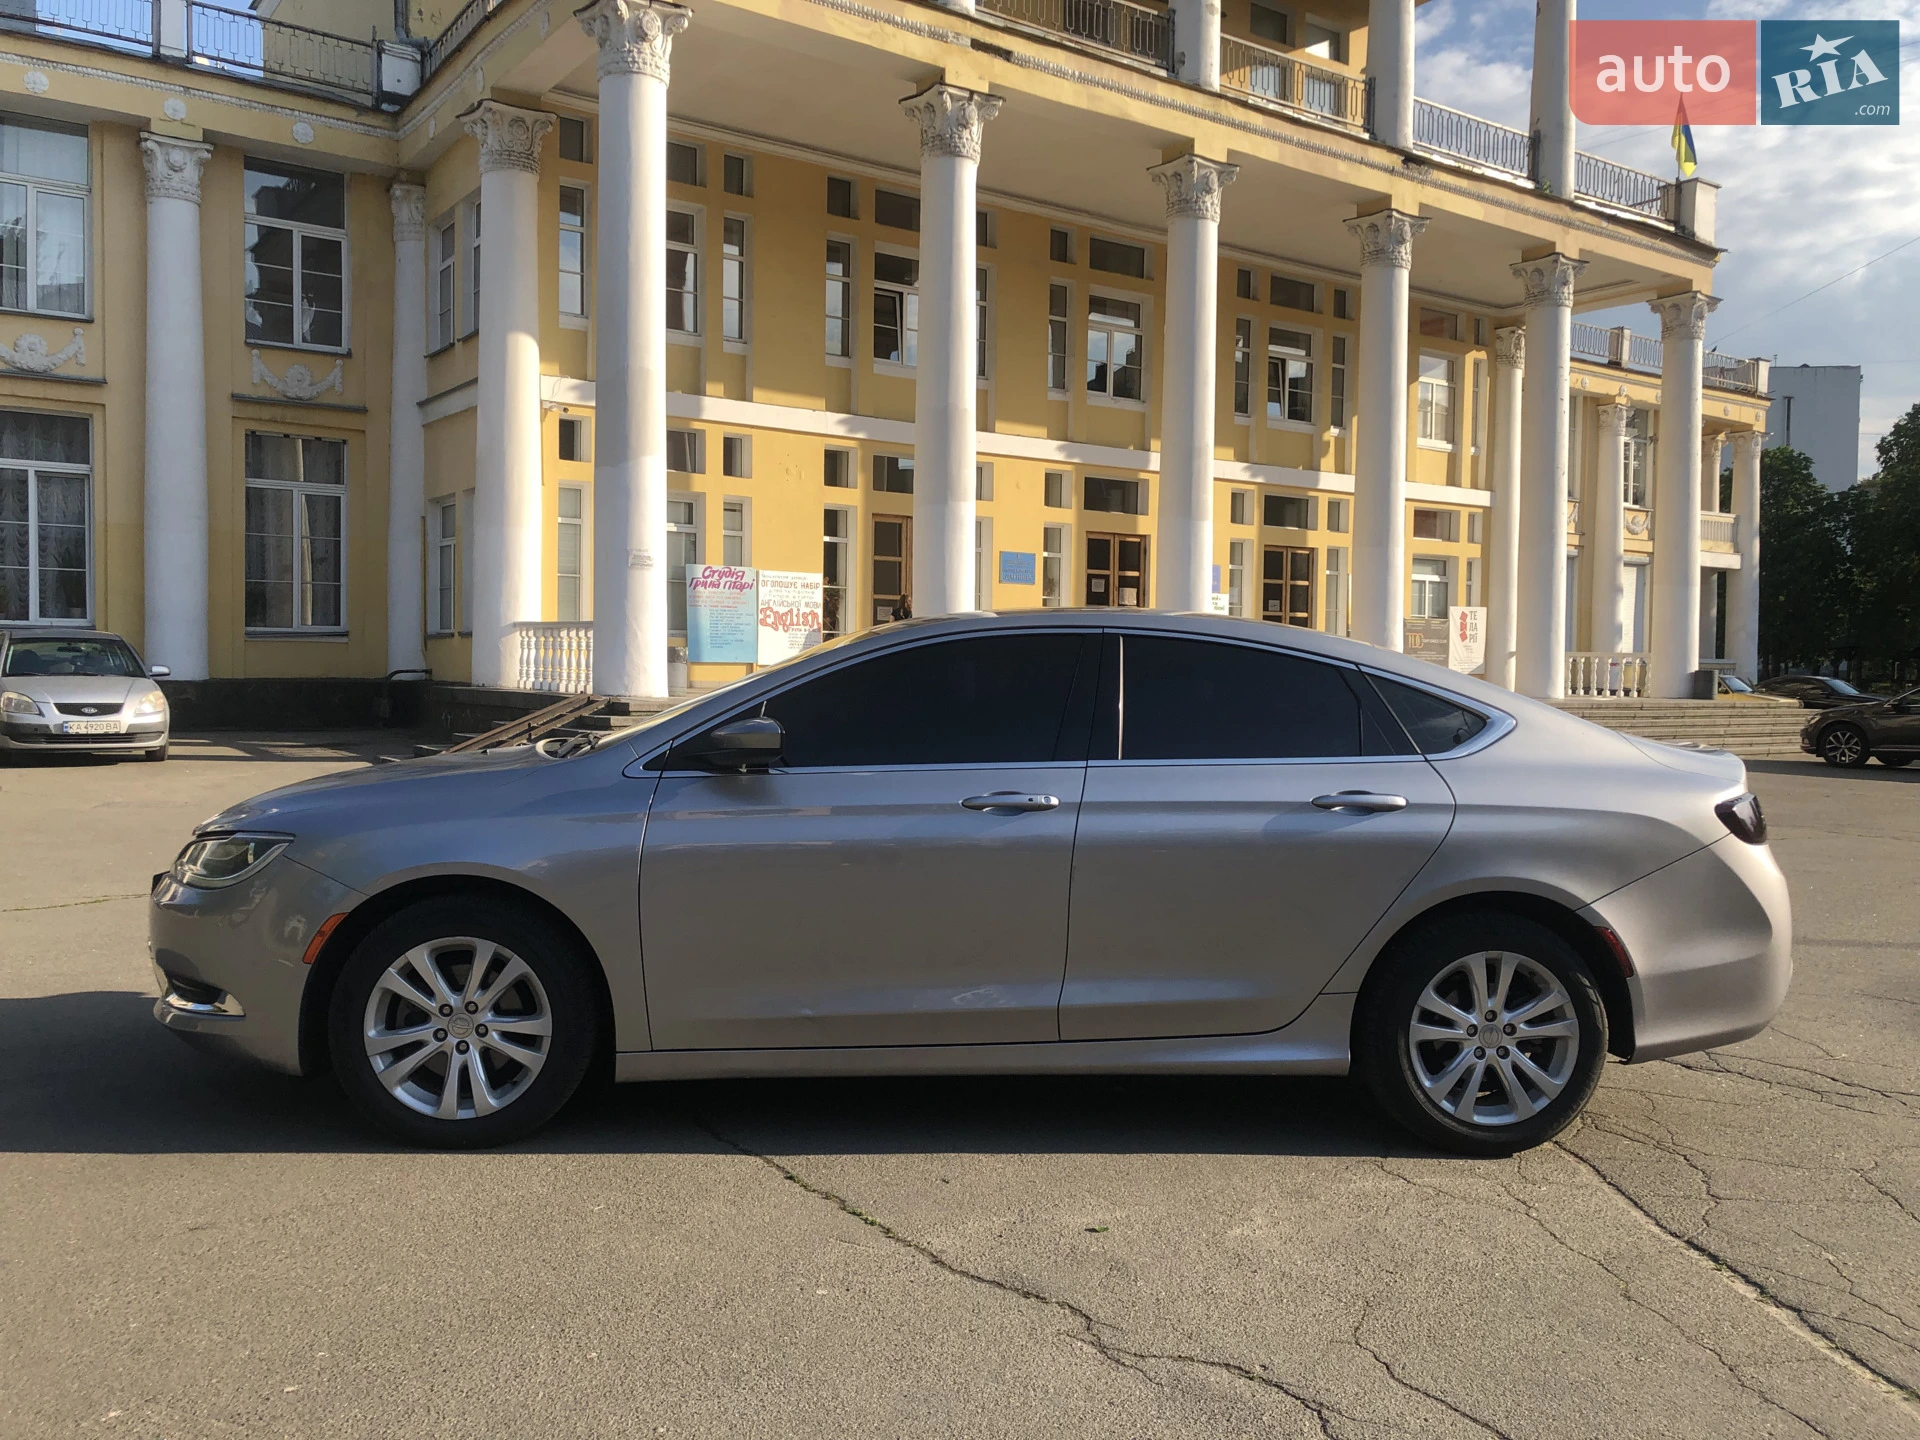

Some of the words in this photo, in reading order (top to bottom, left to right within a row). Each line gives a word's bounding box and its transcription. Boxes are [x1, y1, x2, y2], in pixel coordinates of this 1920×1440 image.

[702, 566, 745, 581] Студія
[723, 579, 755, 592] гітарі
[761, 579, 798, 590] ОГОЛОШУЄ
[800, 581, 820, 590] НАБІР
[759, 606, 822, 633] English
